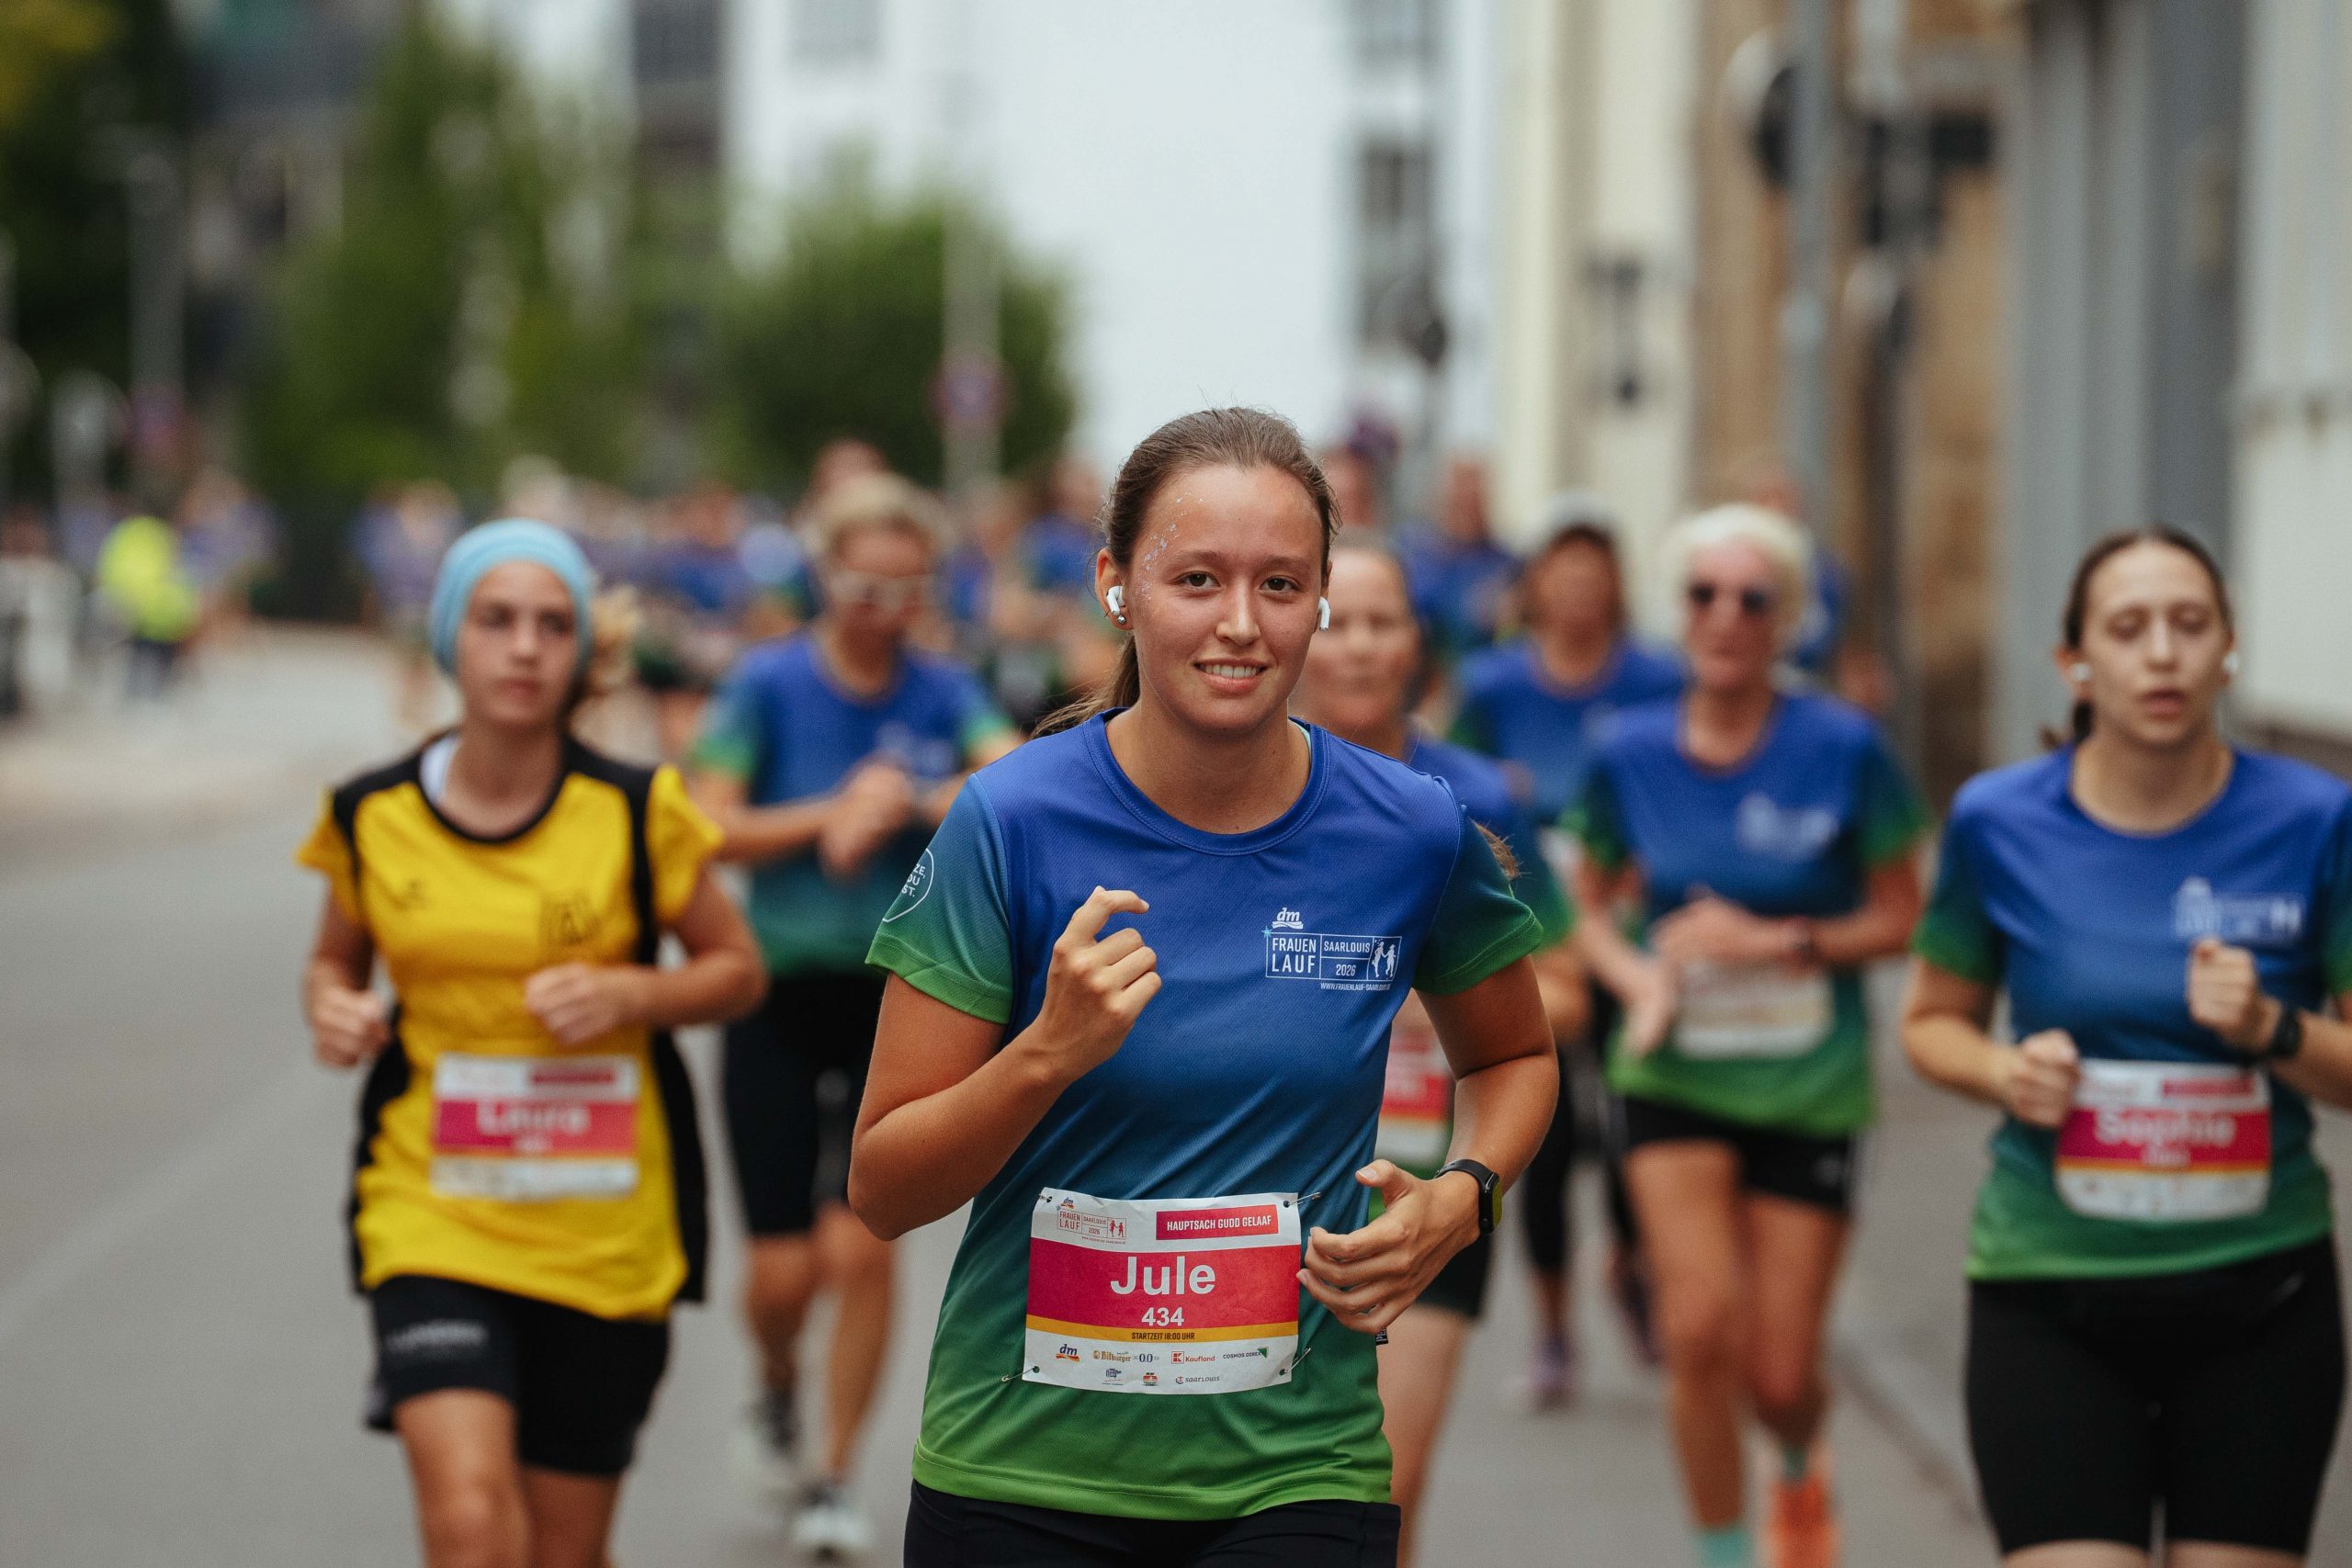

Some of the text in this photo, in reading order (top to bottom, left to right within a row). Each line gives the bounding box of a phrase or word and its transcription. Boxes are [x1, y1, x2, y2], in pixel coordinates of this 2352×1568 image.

[1276, 907, 1300, 921] dm
[1272, 937, 1317, 953] FRAUEN
[1323, 941, 1371, 953] SAARLOUIS
[1272, 953, 1316, 974] LAUF
[1335, 964, 1356, 976] 2026
[1063, 1196, 1074, 1205] dm
[1059, 1211, 1080, 1222] FRAUEN
[1083, 1215, 1107, 1225] SAARLOUIS
[1167, 1214, 1272, 1231] HAUPTSACH GUDD GELAAF
[1059, 1219, 1080, 1231] LAUF
[1110, 1256, 1216, 1295] Jule
[1141, 1307, 1184, 1326] 434
[1131, 1332, 1163, 1340] STARTZEIT
[1182, 1332, 1195, 1340] UHR
[1059, 1344, 1078, 1356] dm
